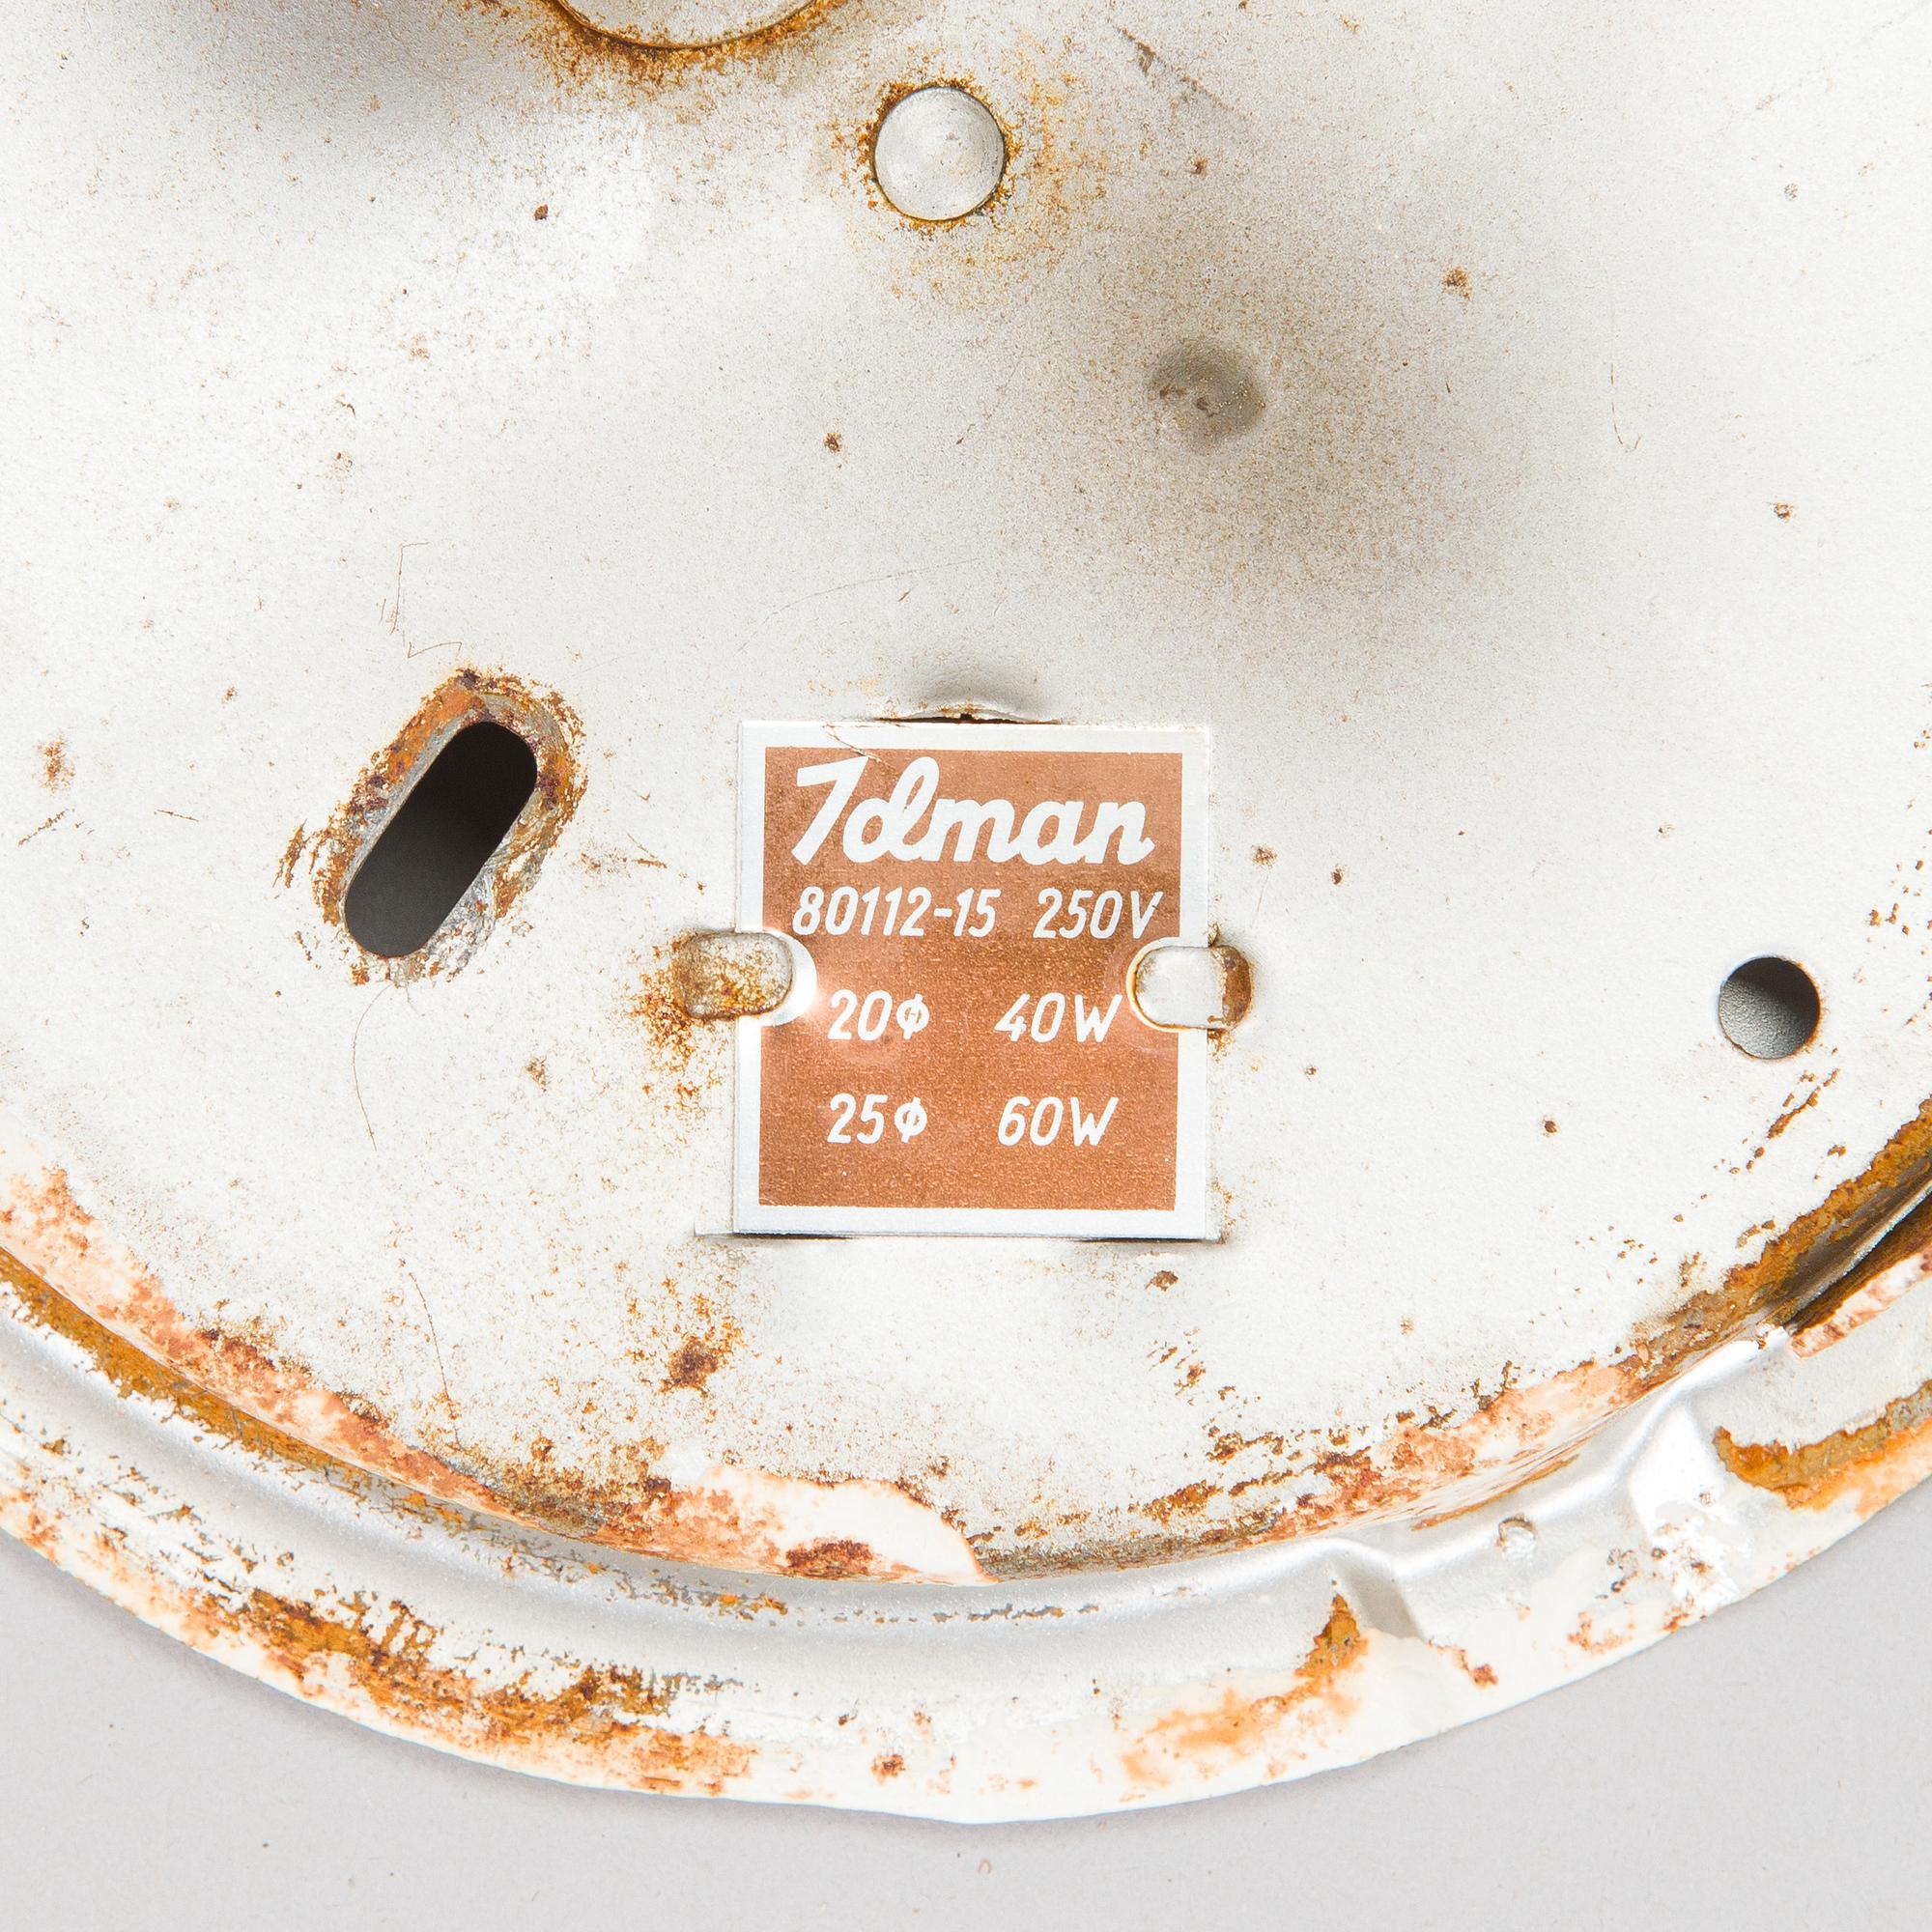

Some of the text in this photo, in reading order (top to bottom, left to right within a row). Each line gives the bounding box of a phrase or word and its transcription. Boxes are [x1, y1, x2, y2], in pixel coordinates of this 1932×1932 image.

[792, 886, 1164, 940] 80112-15 250V
[994, 992, 1124, 1044] 40W
[997, 1095, 1120, 1148] 60W
